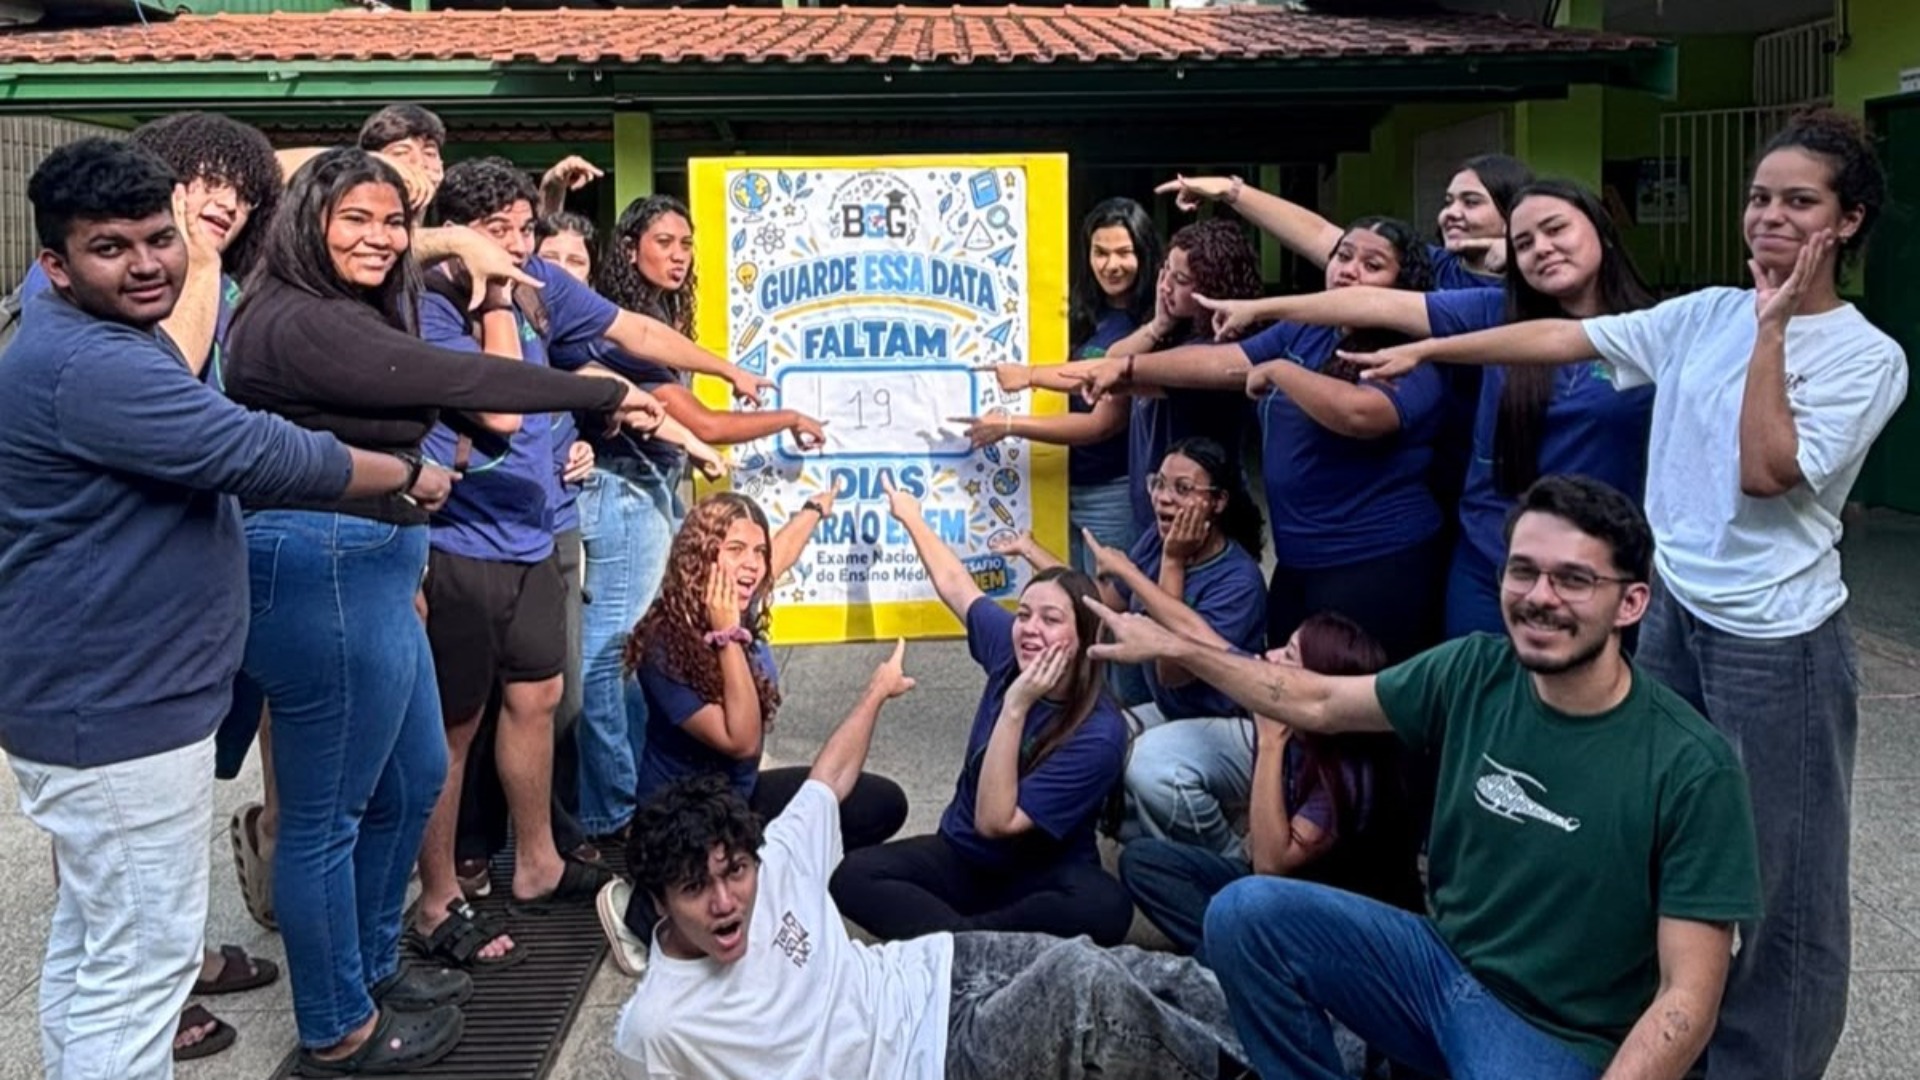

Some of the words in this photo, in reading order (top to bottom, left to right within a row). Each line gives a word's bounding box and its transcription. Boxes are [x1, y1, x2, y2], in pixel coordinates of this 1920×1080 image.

[761, 256, 857, 310] GUARDE
[864, 254, 925, 292] ESSA
[932, 258, 997, 312] DATA
[804, 320, 947, 360] FALTAM
[849, 388, 892, 430] 19
[830, 466, 925, 500] DIAS
[861, 510, 881, 545] O
[885, 509, 967, 545] EEM
[816, 568, 834, 582] do
[839, 567, 890, 582] Ensino
[893, 566, 930, 582] Médi
[817, 551, 868, 565] Exame
[873, 550, 919, 565] Nacio
